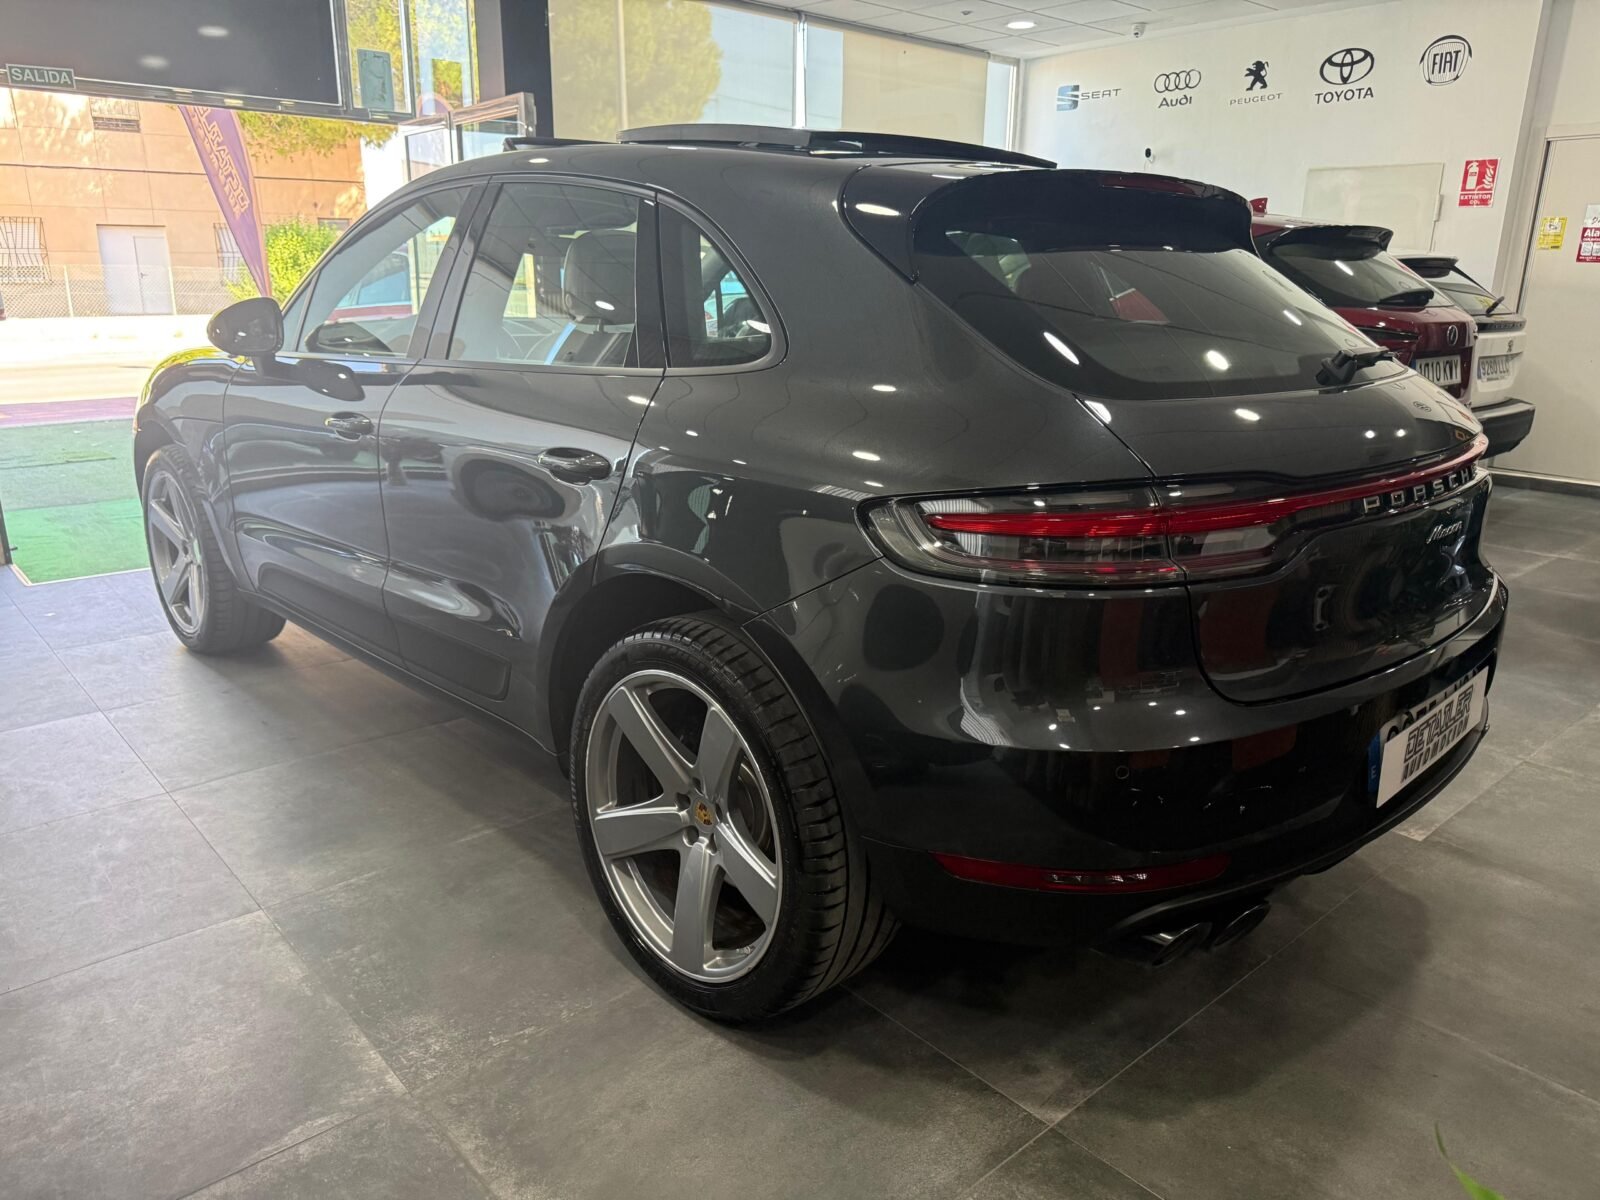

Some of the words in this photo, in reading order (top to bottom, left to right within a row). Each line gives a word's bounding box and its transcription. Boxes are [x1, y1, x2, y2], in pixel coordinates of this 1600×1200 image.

[1431, 50, 1462, 75] FIAT
[10, 68, 71, 85] SALIDA
[1080, 88, 1122, 101] SEAT
[1158, 95, 1193, 109] Audi
[1229, 93, 1283, 105] PEUGEOT
[1315, 87, 1374, 104] TOYOTA
[1363, 465, 1476, 513] PORSCHE
[1404, 684, 1474, 763] DETAILER
